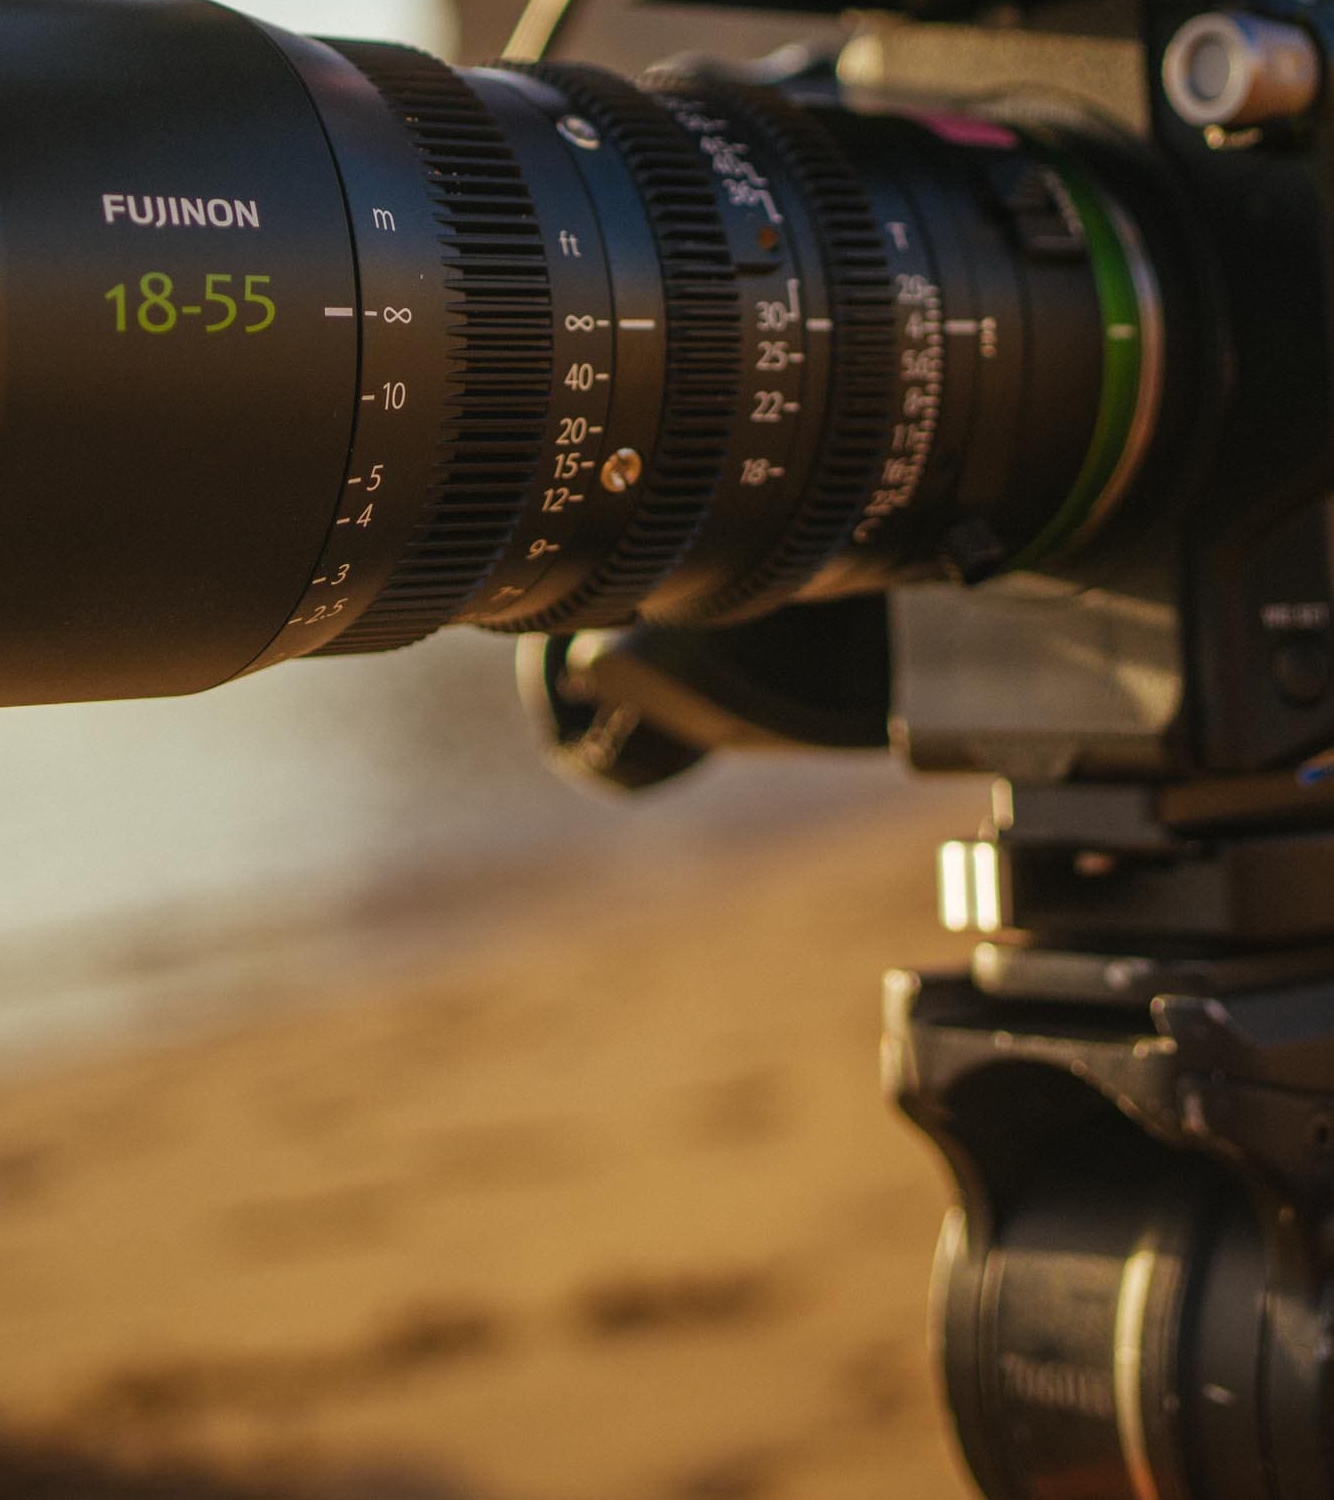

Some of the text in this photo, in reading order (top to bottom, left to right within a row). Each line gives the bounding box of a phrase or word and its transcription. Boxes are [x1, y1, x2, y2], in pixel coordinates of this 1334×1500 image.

[101, 193, 261, 228] FUJINON
[372, 207, 396, 232] m
[559, 229, 582, 258] ft
[103, 271, 276, 334] 18-55
[754, 300, 789, 333] 30
[754, 340, 789, 372] 25
[563, 362, 594, 392] 40
[382, 381, 407, 411] 10
[749, 389, 785, 423] 22
[554, 416, 588, 446] 20
[366, 464, 384, 492] 5
[553, 451, 582, 480] 15
[739, 457, 770, 487] 18
[541, 486, 571, 513] 12
[356, 502, 374, 528] 4
[525, 538, 548, 561] 9
[330, 563, 351, 586] 3
[304, 596, 350, 626] 2.5
